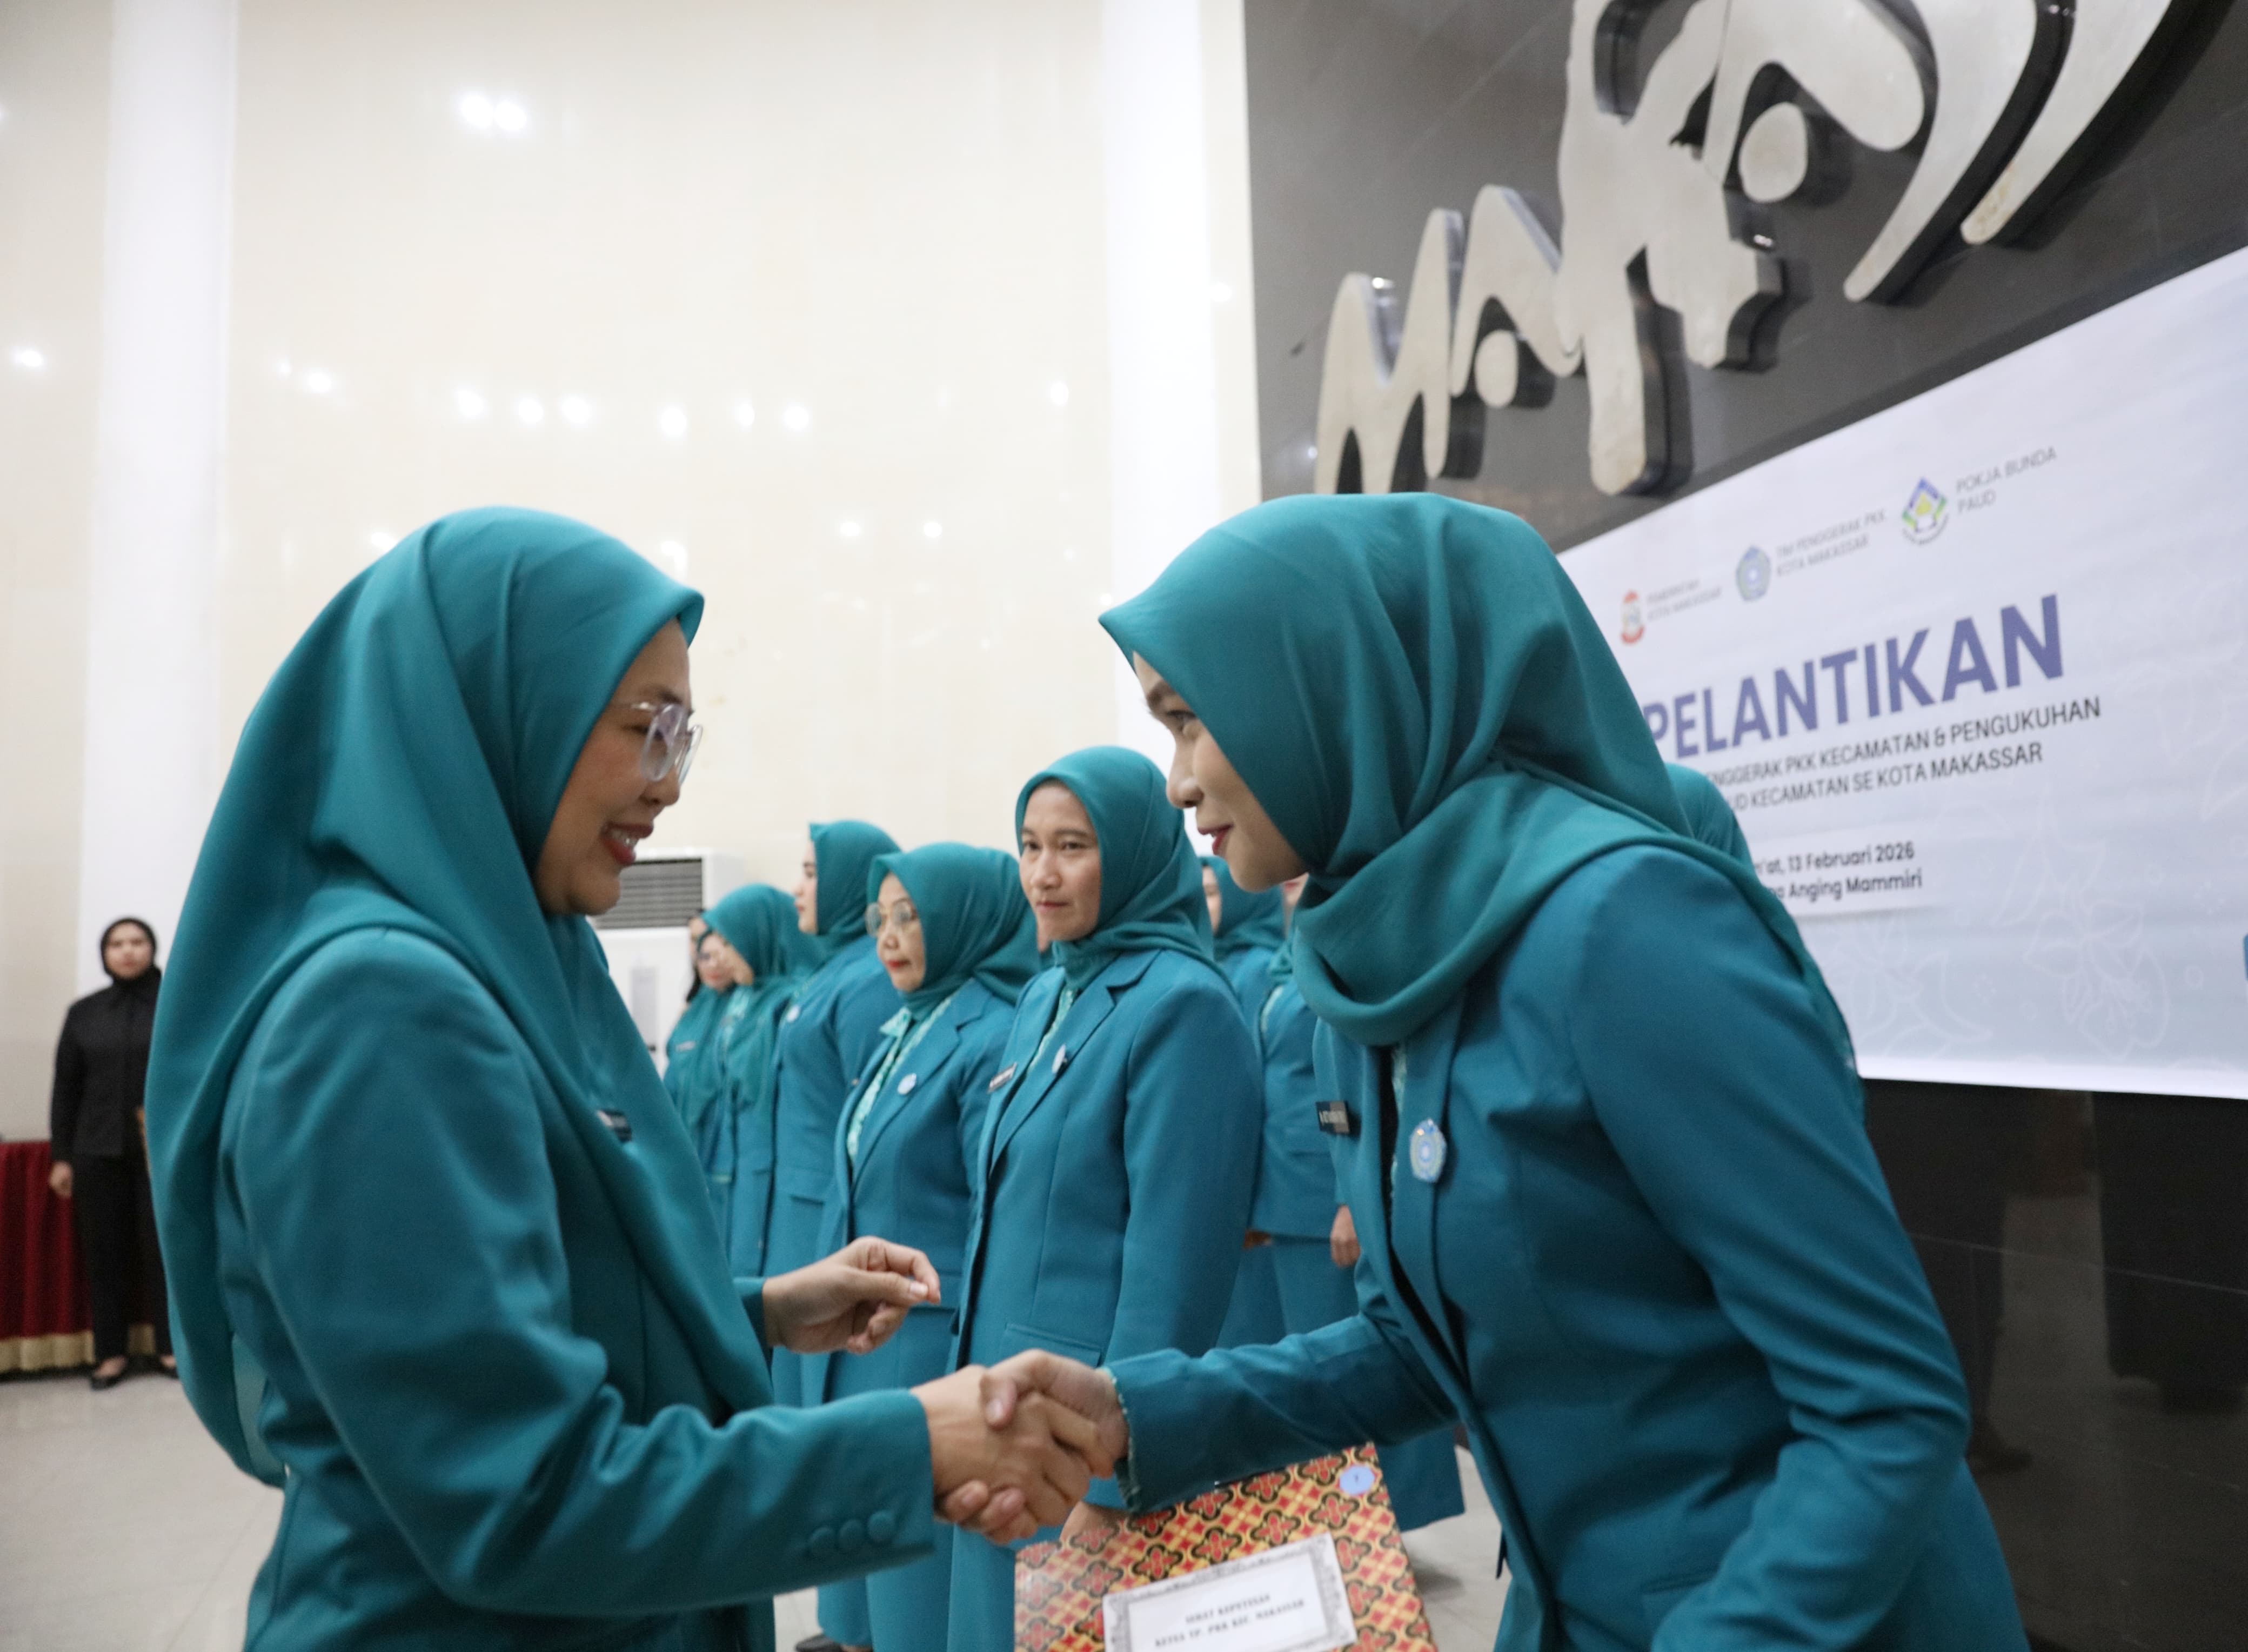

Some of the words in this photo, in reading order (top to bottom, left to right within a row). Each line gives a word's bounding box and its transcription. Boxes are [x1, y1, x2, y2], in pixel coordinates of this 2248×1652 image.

[1956, 466, 2003, 493] POKJA
[2004, 446, 2057, 477] BUNDA
[1957, 488, 1997, 514] PAUD
[1643, 593, 2064, 758] PELANTIKAN
[1785, 751, 1817, 773] PKK
[1819, 730, 1930, 768] KECAMATAN
[1933, 727, 1946, 748] &
[1950, 696, 2101, 744] PENGUKUHAN
[1751, 776, 1849, 808] KECAMATAN
[1852, 771, 1874, 792] SE
[1876, 763, 1928, 788] KOTA
[1931, 742, 2043, 779] MAKASSAR
[1788, 854, 1802, 872] 13
[1806, 845, 1872, 870] Februari
[1875, 840, 1916, 863] 2026
[1789, 878, 1842, 902] Anging
[1845, 867, 1922, 893] Mammiri
